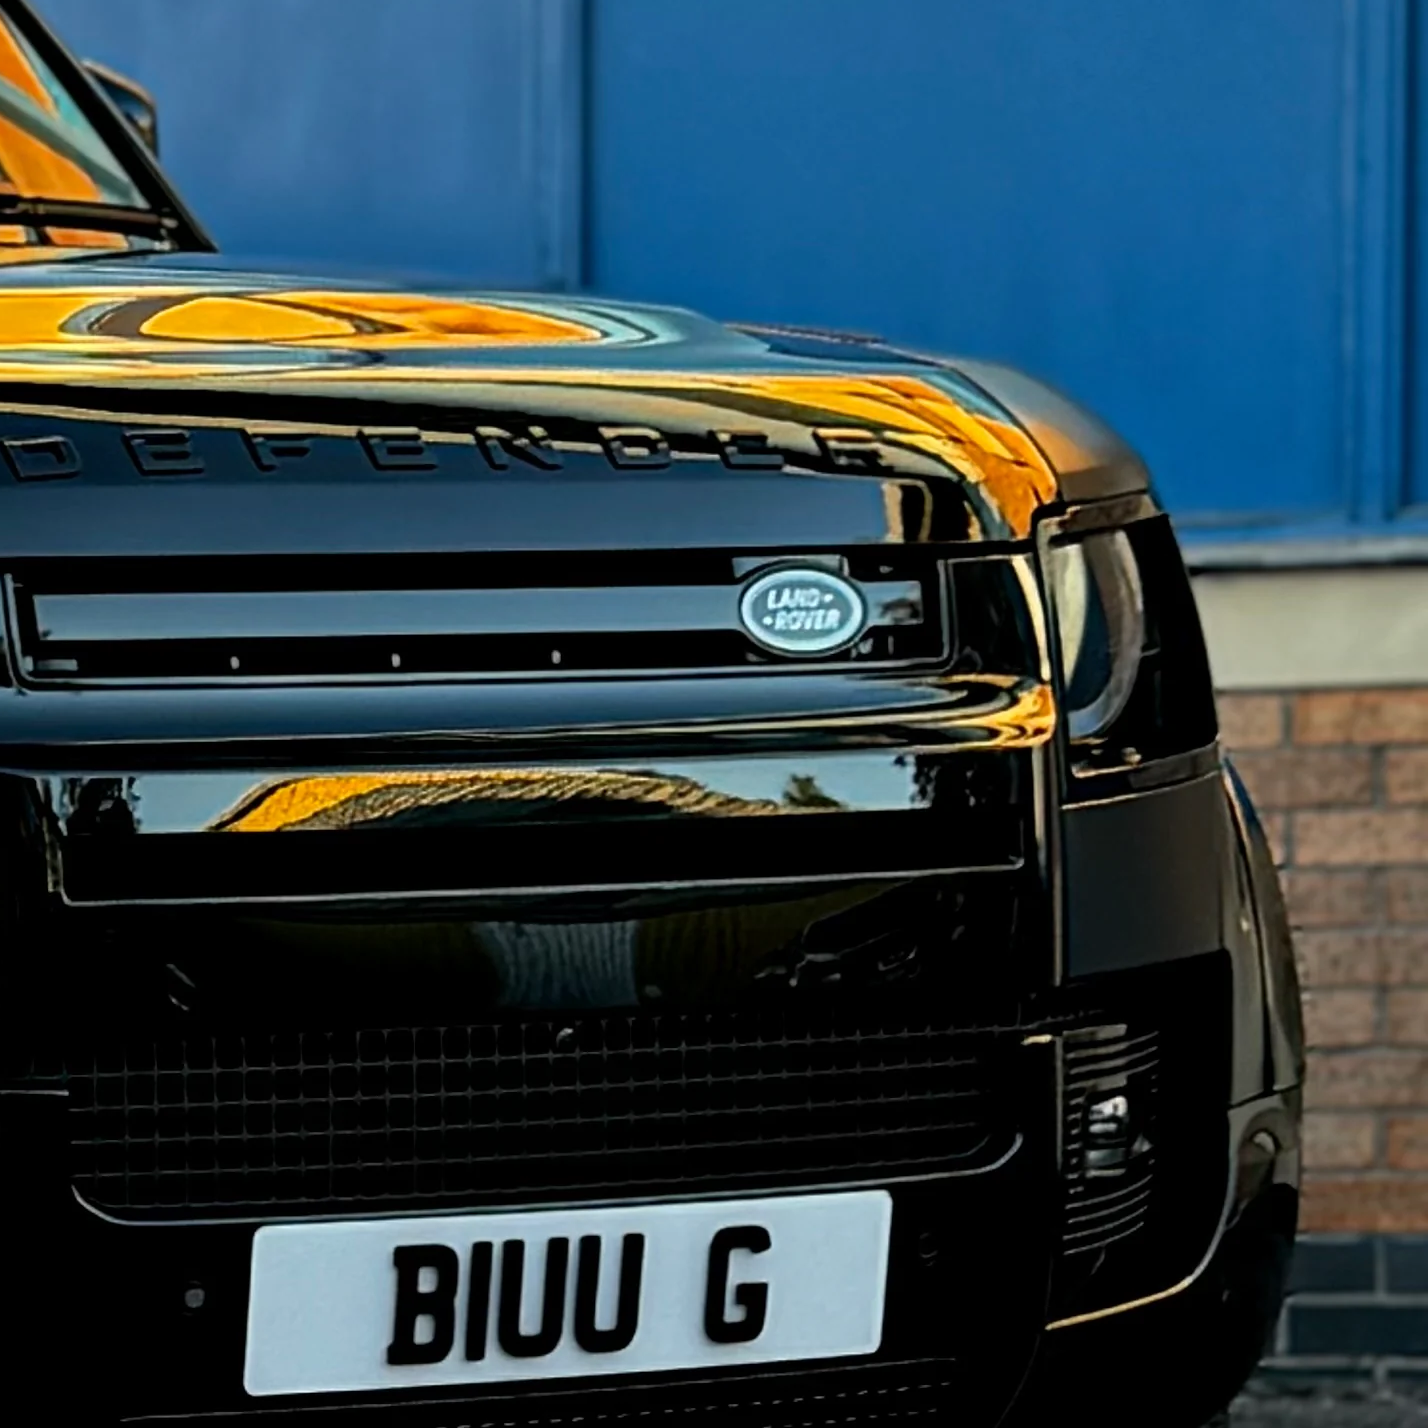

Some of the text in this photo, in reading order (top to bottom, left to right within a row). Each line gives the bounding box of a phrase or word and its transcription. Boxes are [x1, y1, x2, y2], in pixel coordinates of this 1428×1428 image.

[767, 587, 821, 609] LAND
[775, 609, 841, 631] ROVER
[702, 1224, 772, 1344] G
